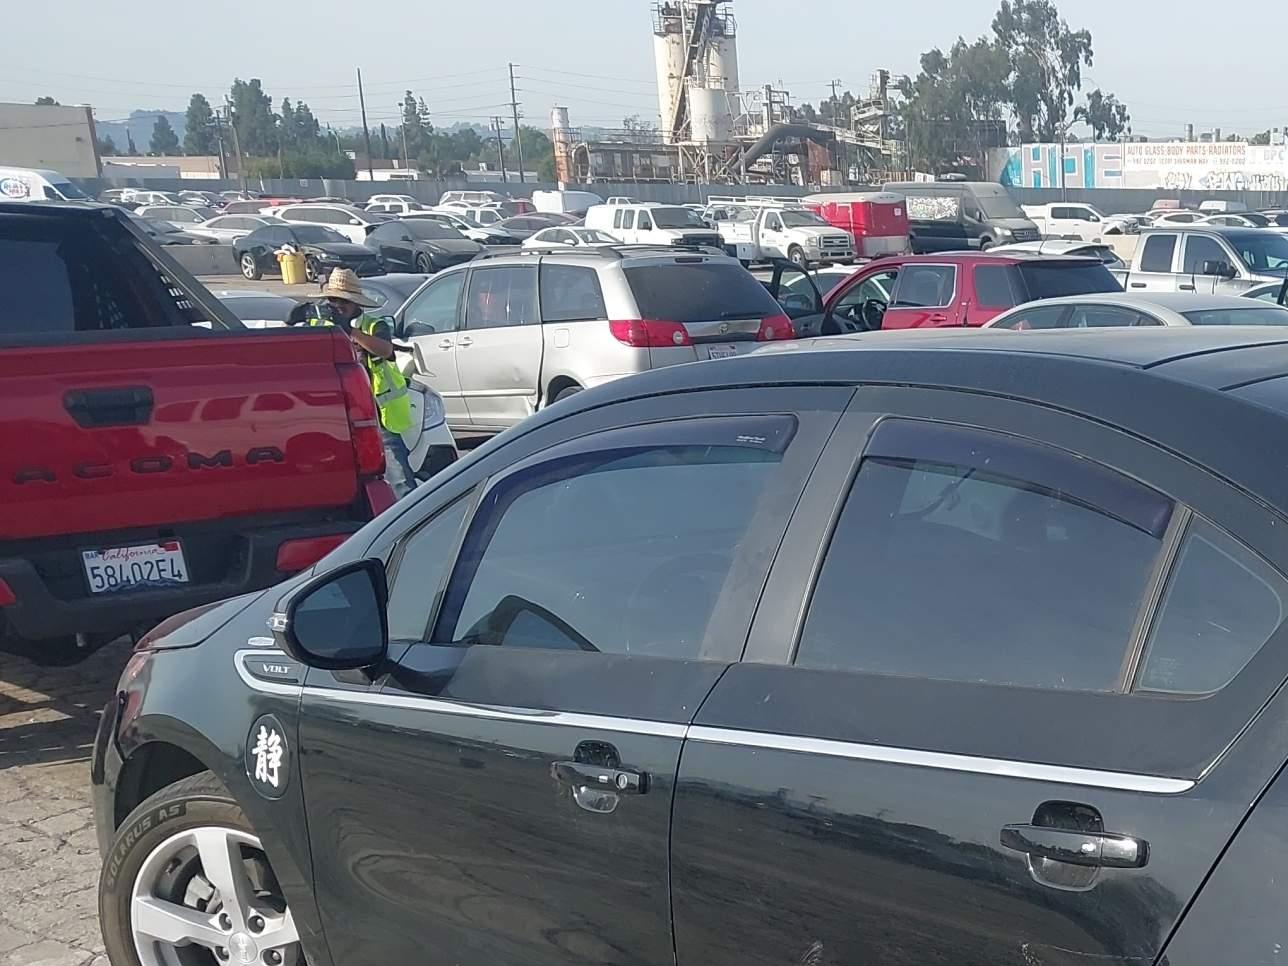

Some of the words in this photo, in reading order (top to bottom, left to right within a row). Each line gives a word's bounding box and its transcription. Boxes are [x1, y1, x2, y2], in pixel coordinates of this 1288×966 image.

[1127, 145, 1143, 156] AUTO
[1144, 145, 1165, 156] GLASS
[1166, 145, 1184, 156] BODY
[1186, 145, 1206, 155] PARTS
[1208, 145, 1246, 155] RADIATORS
[14, 446, 285, 484] ACOMA
[262, 663, 291, 674] VOLT
